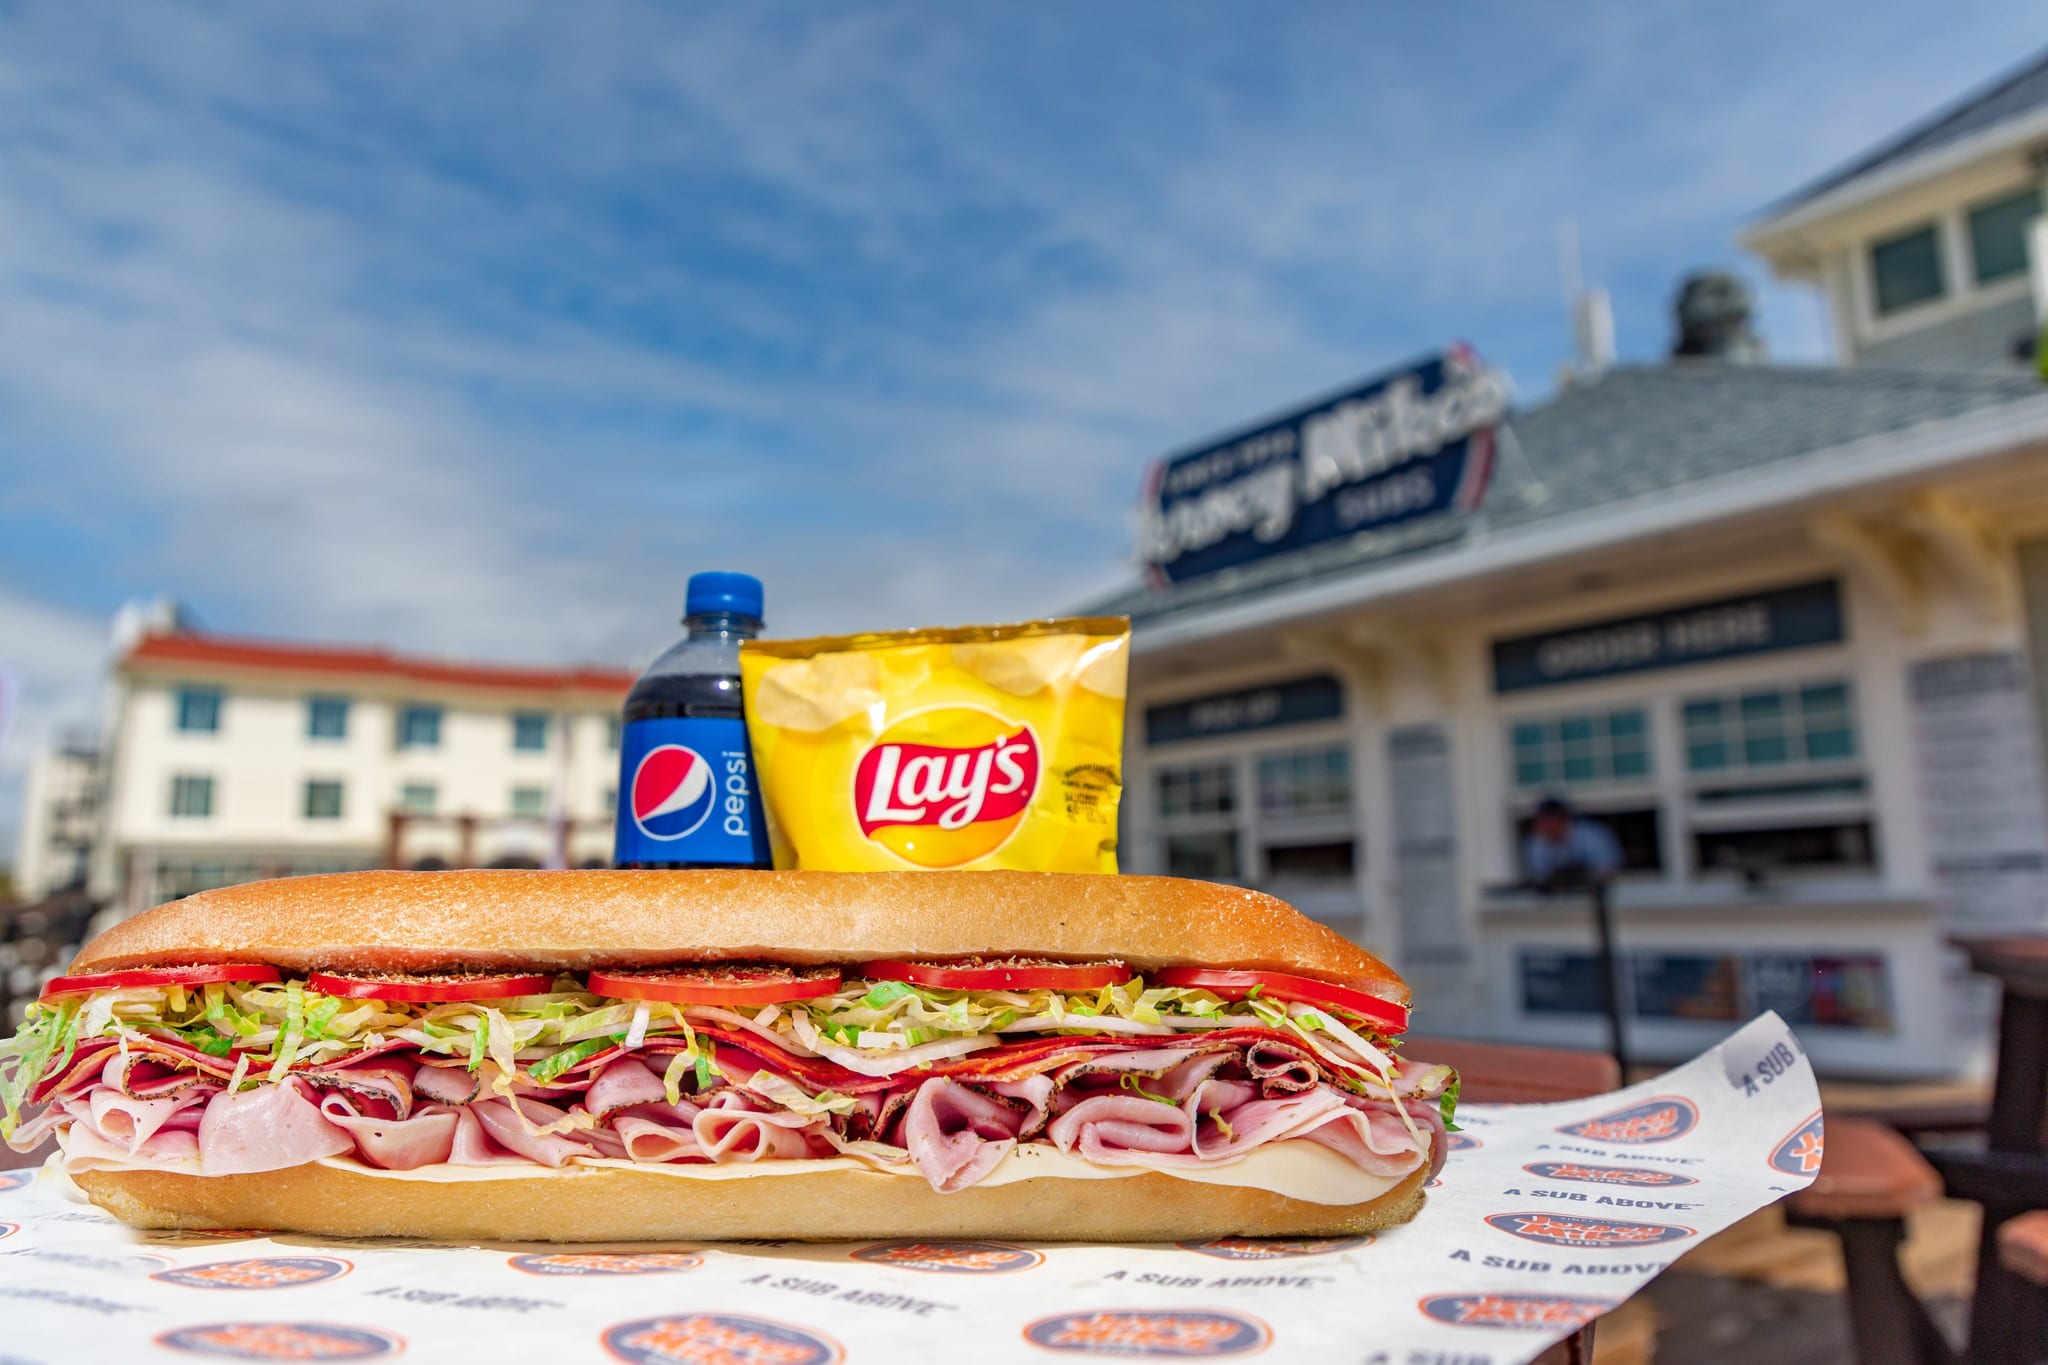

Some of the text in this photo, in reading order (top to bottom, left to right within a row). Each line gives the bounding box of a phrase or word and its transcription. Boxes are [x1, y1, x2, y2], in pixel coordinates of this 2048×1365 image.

[721, 750, 751, 837] pepsi
[865, 734, 1030, 831] Lay's
[1742, 1041, 1796, 1098] A SUB
[1503, 1188, 1693, 1211] A SUB ABOVE
[1135, 1272, 1204, 1289] SUB
[1206, 1275, 1318, 1290] ABOVE
[1448, 1248, 1472, 1263] A
[1481, 1255, 1552, 1274] SUB
[770, 1276, 839, 1297] SUB
[834, 1289, 938, 1318] ABOVE
